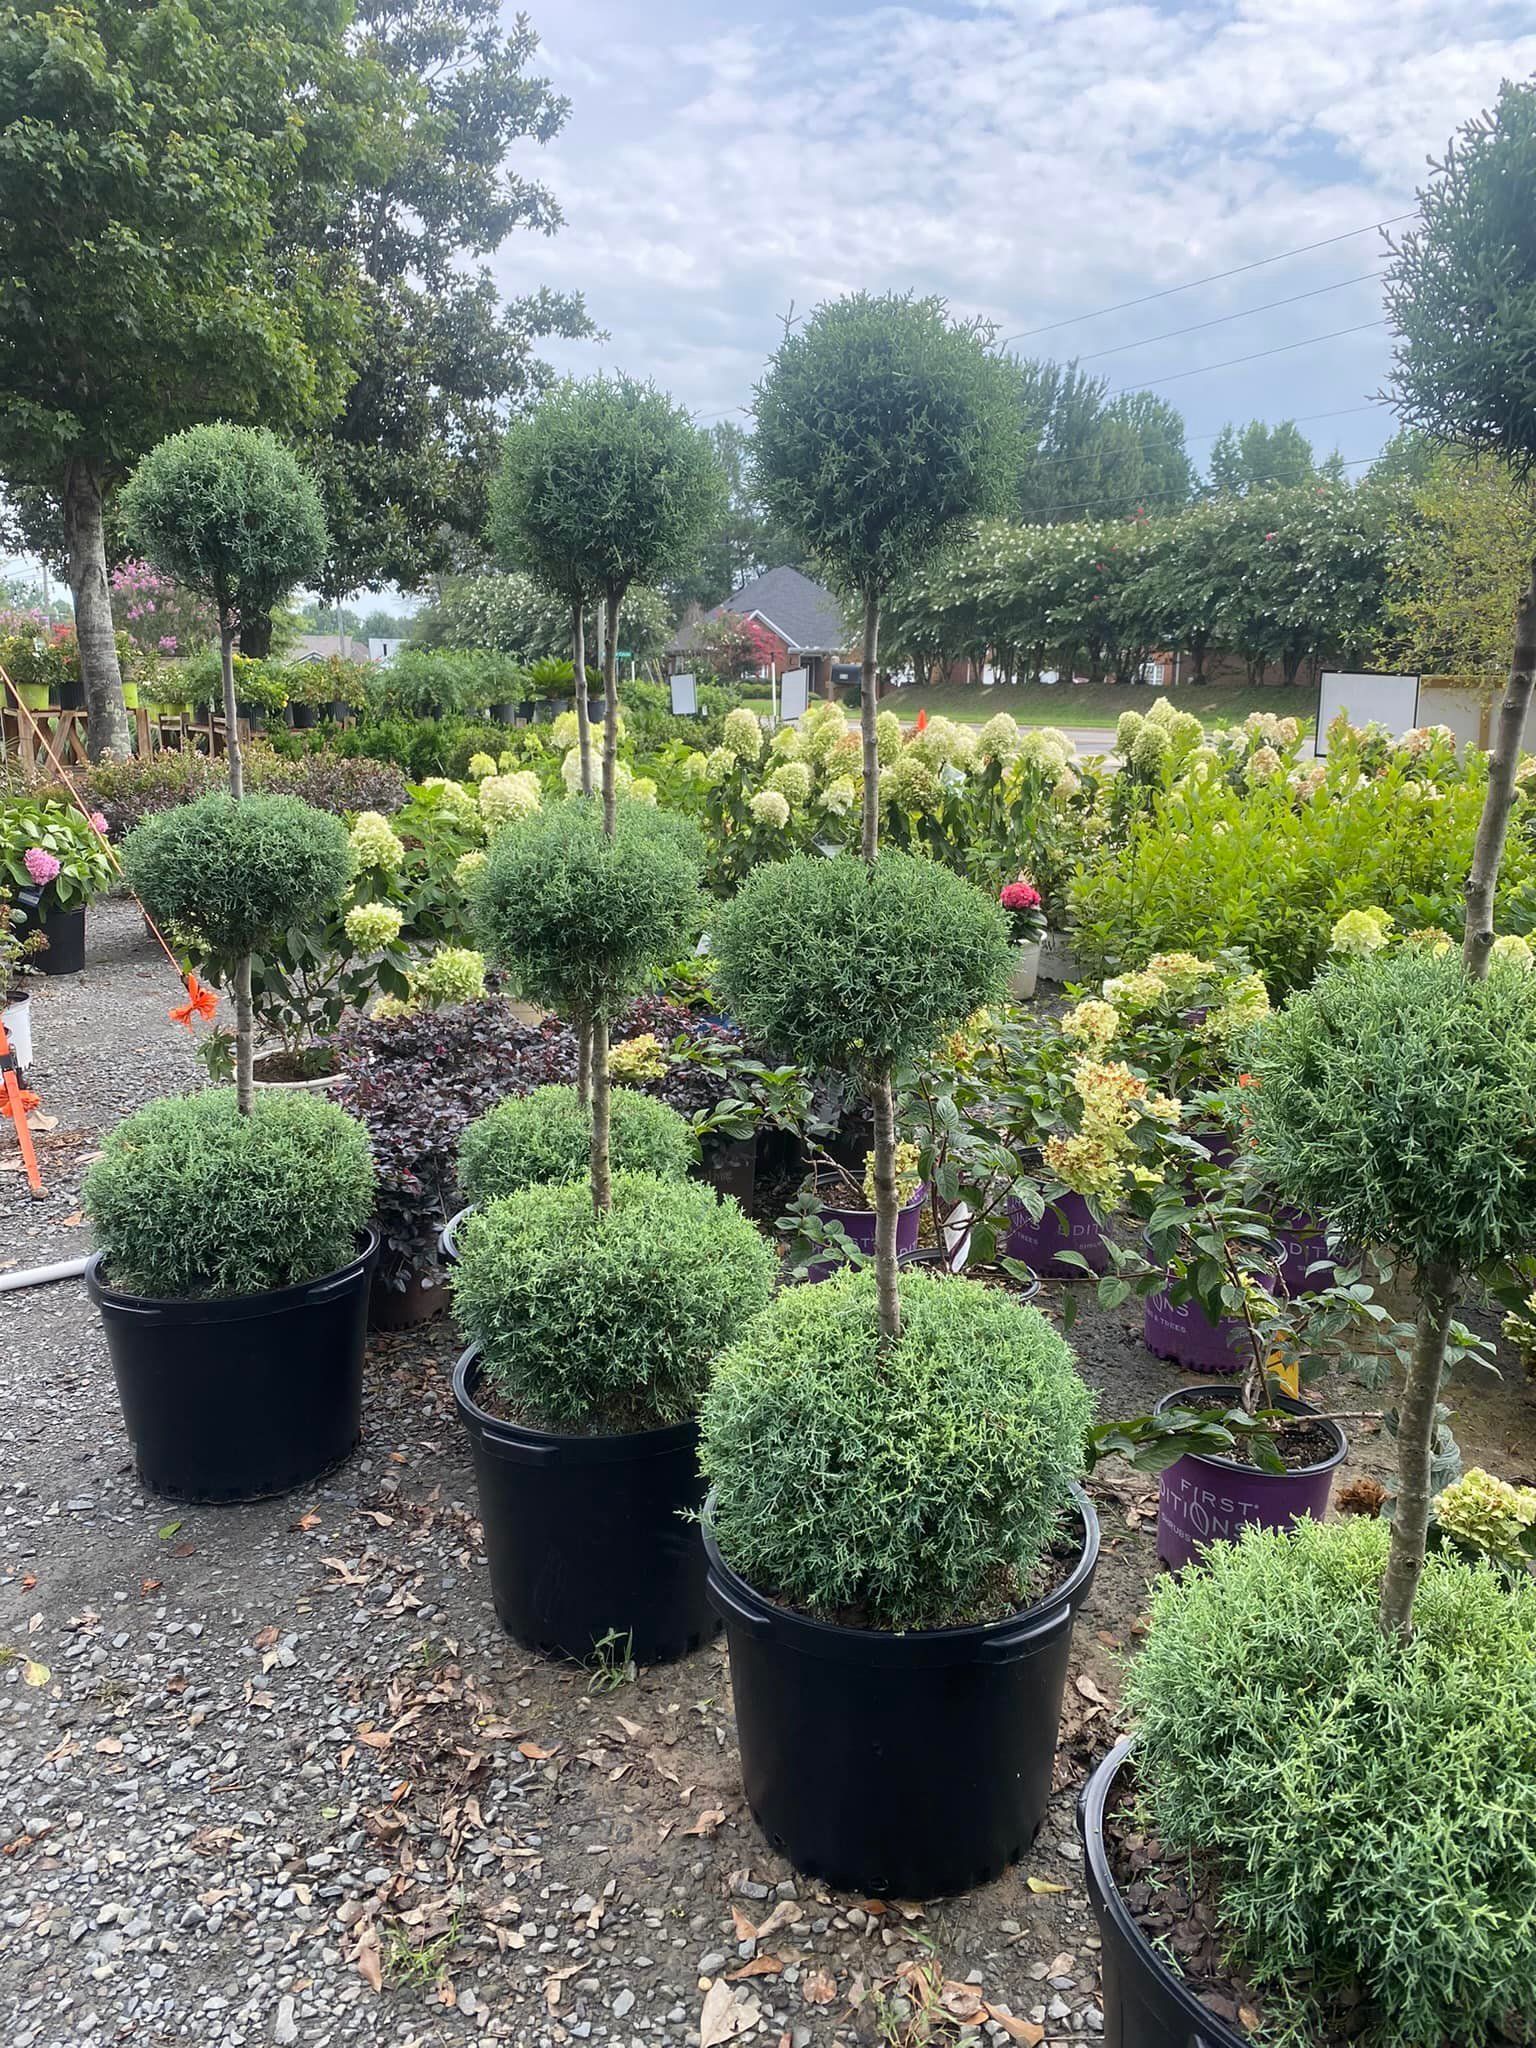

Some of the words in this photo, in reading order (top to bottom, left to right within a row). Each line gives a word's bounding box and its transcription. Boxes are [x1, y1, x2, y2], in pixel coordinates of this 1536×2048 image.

[1160, 1318, 1187, 1334] TREES
[1159, 1476, 1246, 1539] DITIONS
[1181, 1478, 1253, 1517] FIRST
